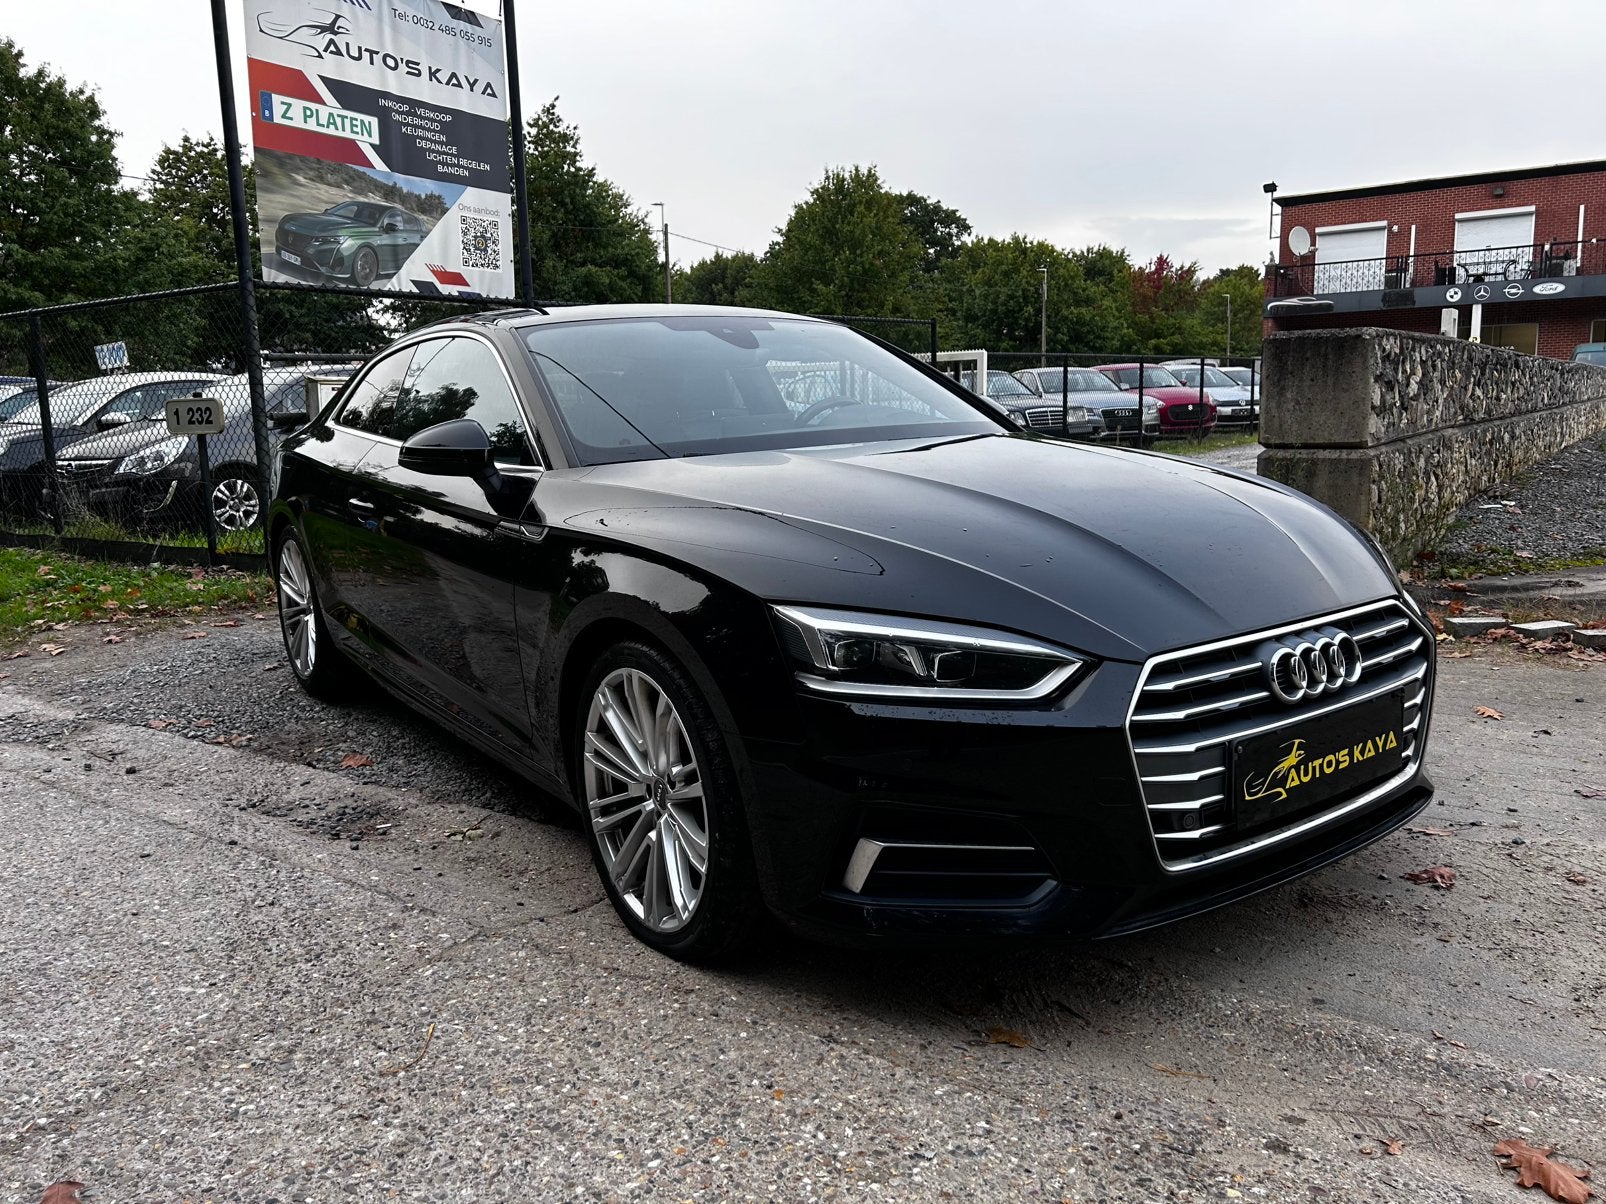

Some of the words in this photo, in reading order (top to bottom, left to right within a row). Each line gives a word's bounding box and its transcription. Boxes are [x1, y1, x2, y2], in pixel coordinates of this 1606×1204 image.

[391, 8, 409, 23] Tel:
[411, 14, 435, 31] 0032
[438, 24, 457, 37] 485
[459, 29, 476, 43] 055
[477, 35, 493, 48] 915
[322, 37, 422, 78] AUTO'S
[428, 65, 498, 99] KAYA
[264, 109, 270, 117] B
[280, 101, 294, 121] Z
[302, 106, 373, 138] PLATEN
[378, 98, 410, 113] INKOOP
[415, 107, 453, 123] VERKOOP
[391, 112, 441, 131] ONDERHOUD
[401, 125, 446, 142] KEURINGEN
[416, 138, 458, 154] DEPANAGE
[426, 152, 458, 164] LICHTEN
[459, 158, 490, 171] REGELEN
[437, 164, 469, 177] BANDEN
[458, 202, 472, 213] Ons
[173, 407, 180, 425] 1
[186, 406, 213, 425] 232
[1285, 748, 1350, 789] AUTO'S
[1353, 730, 1397, 763] KAYA
